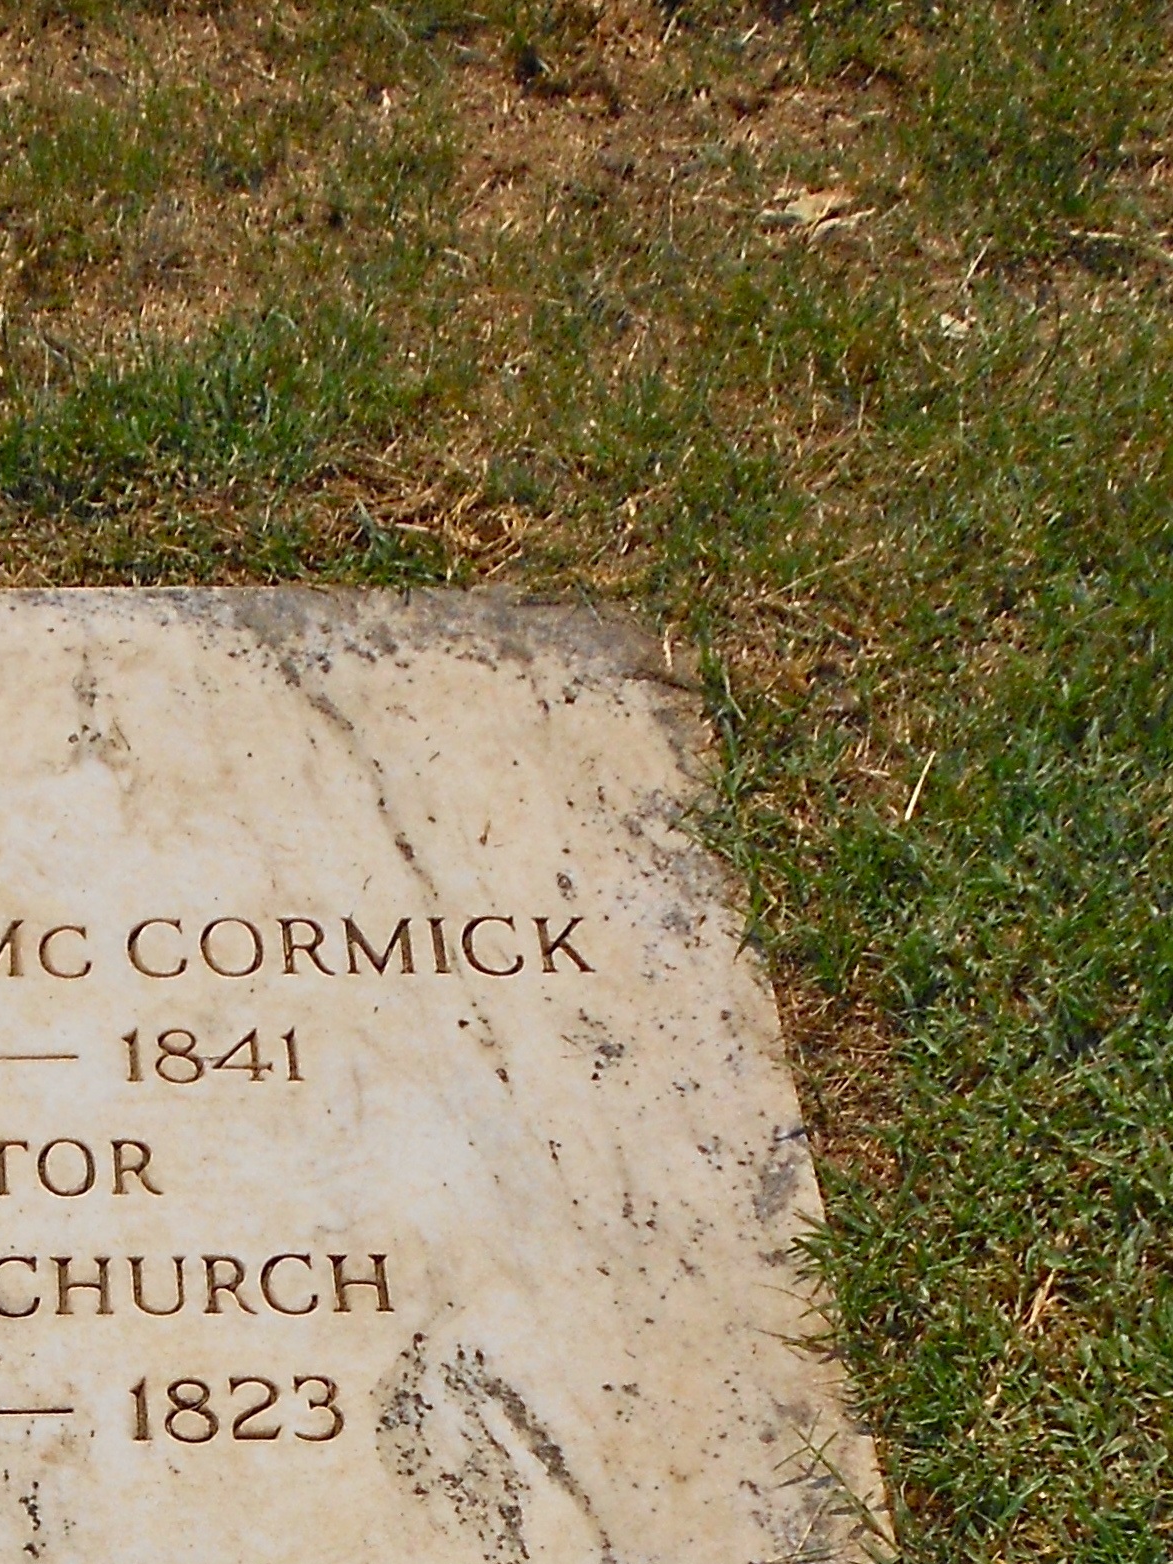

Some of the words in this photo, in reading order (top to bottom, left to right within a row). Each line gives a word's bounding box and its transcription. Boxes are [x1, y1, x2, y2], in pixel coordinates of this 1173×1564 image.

[127, 914, 597, 979] CORMICK
[121, 1027, 306, 1085] 1841
[128, 1374, 345, 1444] 1823
